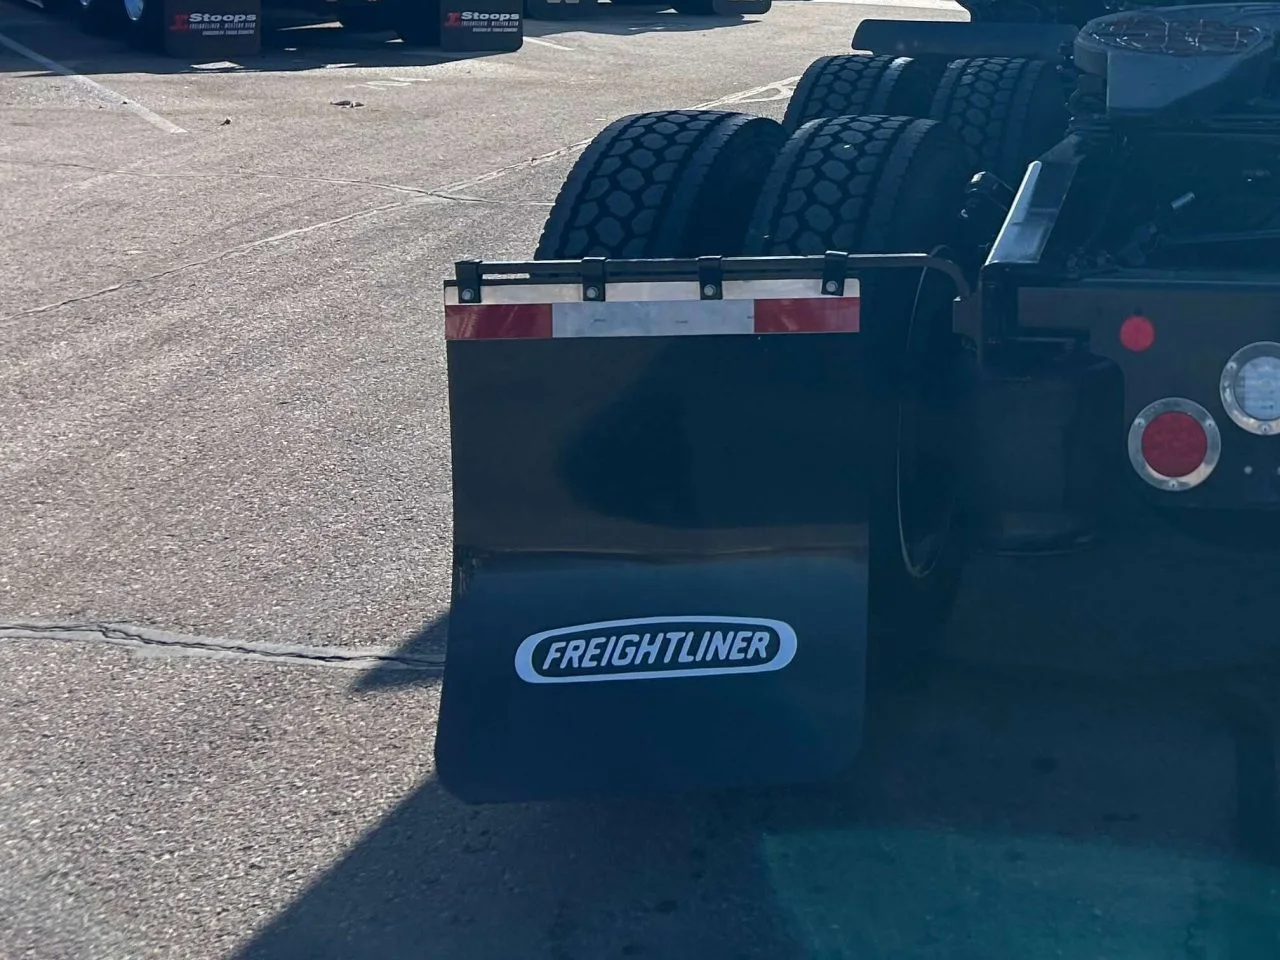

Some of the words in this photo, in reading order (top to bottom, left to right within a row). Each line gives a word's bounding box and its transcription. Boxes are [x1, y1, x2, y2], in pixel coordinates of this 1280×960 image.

[189, 13, 257, 23] Stoops
[461, 11, 520, 22] Stoops
[541, 630, 771, 671] FREIGHTLINER
